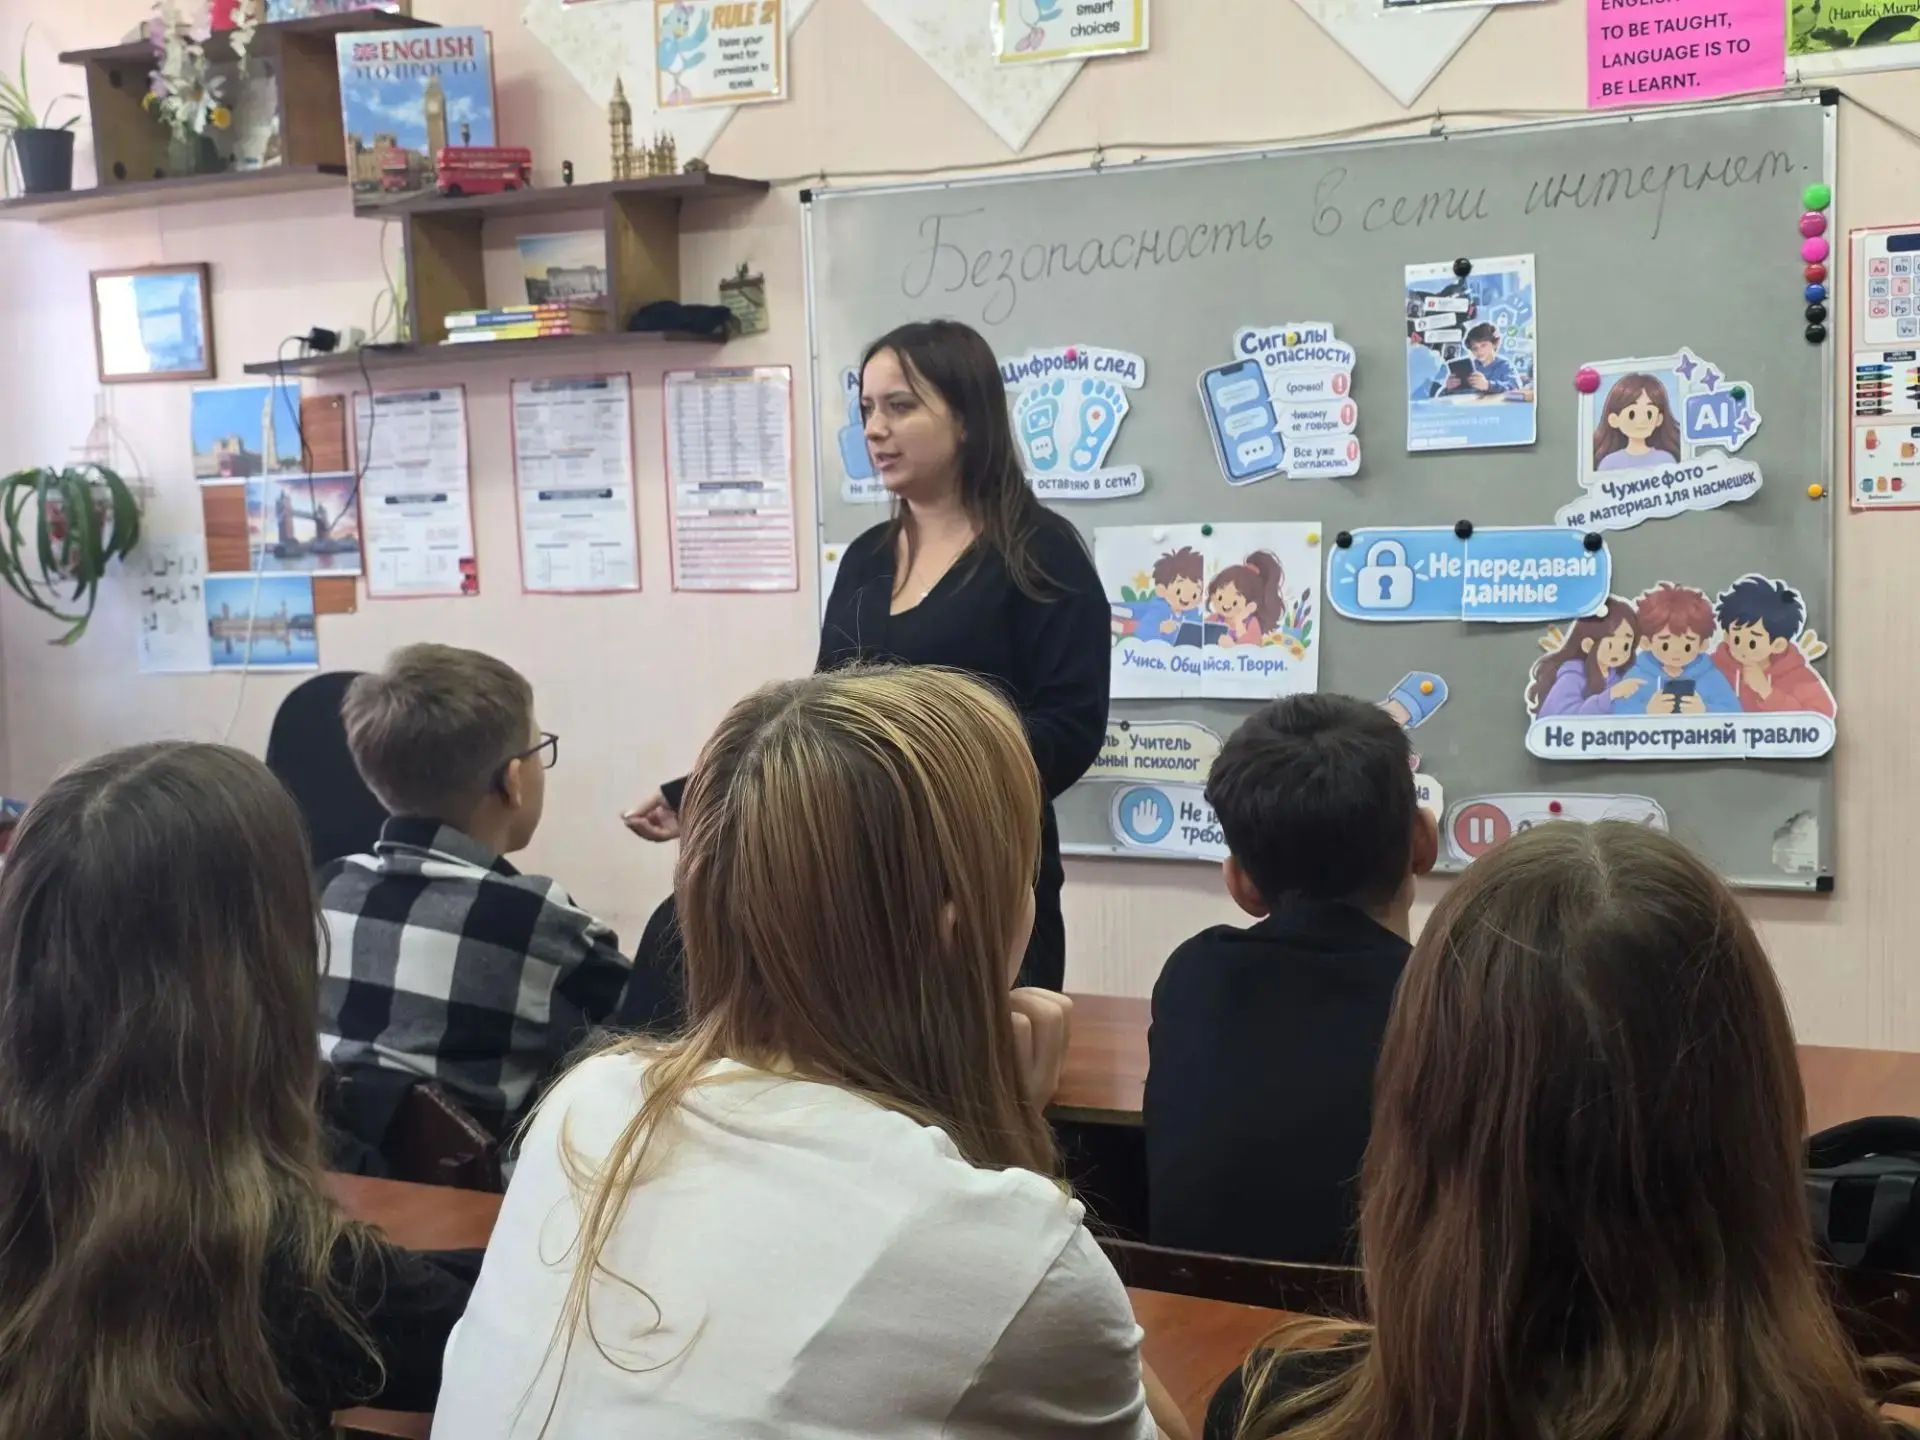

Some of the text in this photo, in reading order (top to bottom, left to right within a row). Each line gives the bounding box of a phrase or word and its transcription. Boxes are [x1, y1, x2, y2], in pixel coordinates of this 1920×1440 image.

[712, 3, 757, 30] RULE
[1601, 12, 1732, 40] TO BE TAUGHT,
[1070, 20, 1120, 38] choices
[381, 35, 474, 62] ENGLISH
[1602, 38, 1750, 69] LANGUAGE IS TO
[1602, 73, 1700, 96] BE LEARNT.
[902, 206, 1274, 326] Безопасность
[1362, 186, 1489, 233] сети
[1524, 149, 1808, 240] интернет.
[1094, 355, 1137, 380] след
[1265, 347, 1350, 366] опасности
[1694, 402, 1729, 431] AI
[1293, 447, 1335, 459] Все уже
[1094, 478, 1101, 490] в
[1105, 472, 1137, 489] сети?
[1601, 478, 1660, 500] Чужие
[1661, 463, 1703, 489] фото
[1567, 513, 1585, 527] не
[1590, 495, 1662, 523] материал
[1694, 471, 1756, 498] насмешек
[1429, 551, 1596, 582] Не передавай
[1462, 582, 1558, 606] данные
[1122, 648, 1167, 670] Учись.
[1237, 655, 1288, 676] Твори.
[1129, 734, 1192, 751] Учитель
[1545, 726, 1575, 747] Не
[1134, 756, 1200, 770] психолог
[1180, 801, 1202, 822] Не
[1181, 825, 1228, 845] требо
